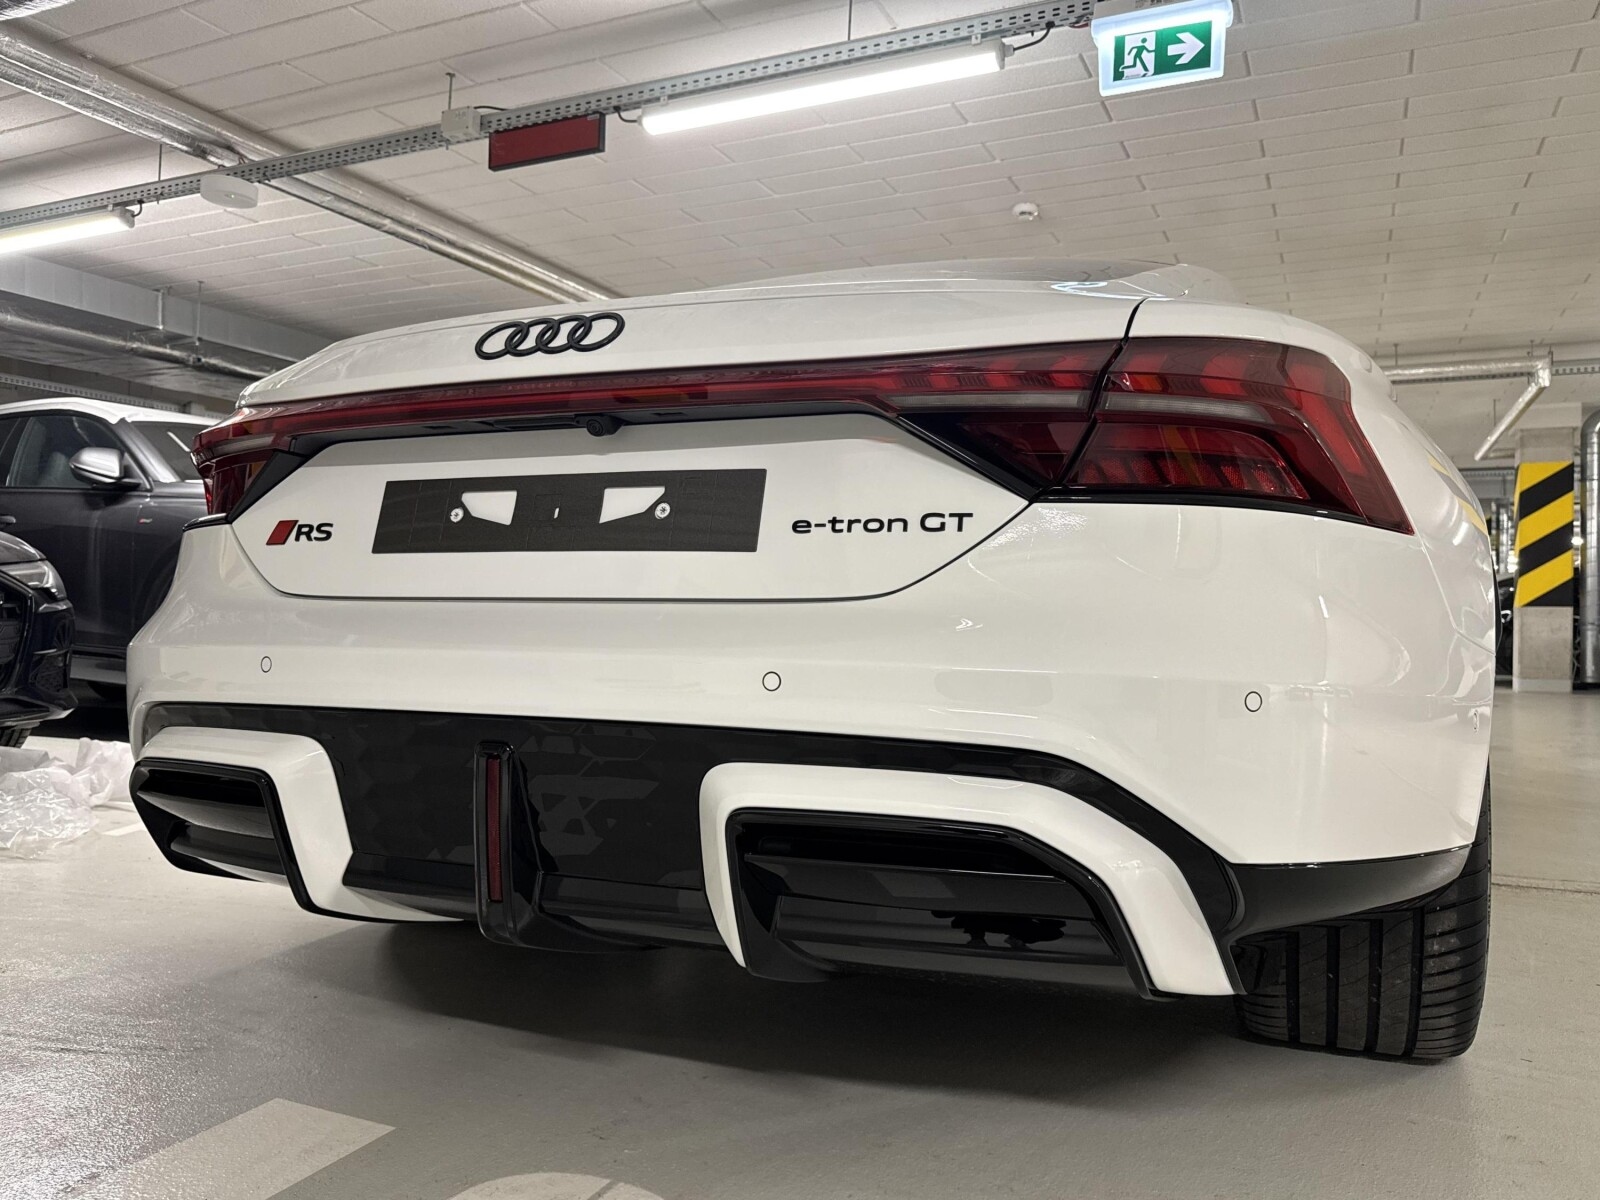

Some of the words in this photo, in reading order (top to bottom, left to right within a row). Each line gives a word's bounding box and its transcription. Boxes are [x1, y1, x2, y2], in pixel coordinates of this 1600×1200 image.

[294, 523, 334, 542] RS
[791, 516, 908, 534] e-tron
[919, 512, 973, 532] GT
